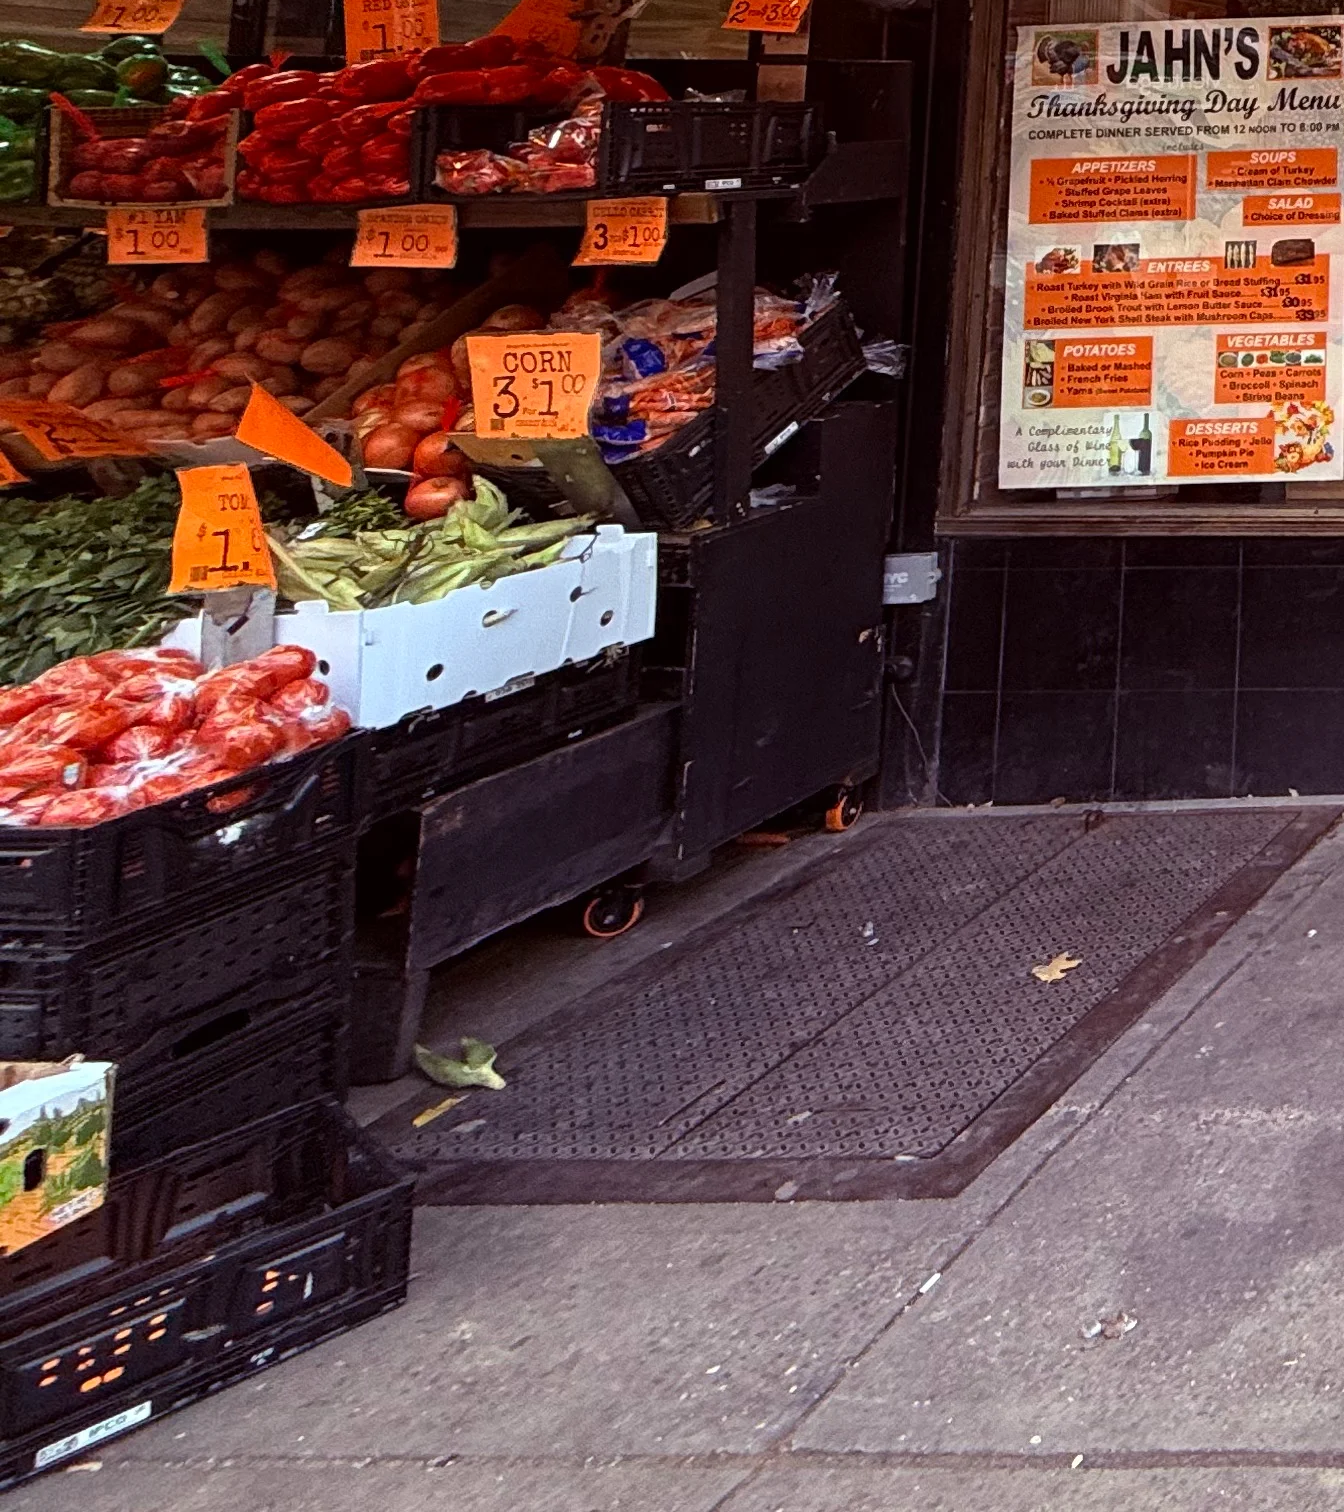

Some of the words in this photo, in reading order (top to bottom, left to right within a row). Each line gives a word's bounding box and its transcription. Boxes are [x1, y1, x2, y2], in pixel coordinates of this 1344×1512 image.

[729, 1, 749, 23] 2
[1107, 27, 1260, 84] JAHN'S
[1027, 94, 1196, 124] Thanksgiving
[1205, 89, 1259, 119] Day
[1267, 87, 1342, 113] Menu
[1028, 129, 1092, 140] COMPLETE
[1096, 127, 1141, 138] DINNER
[1145, 126, 1193, 137] SERVED
[1197, 125, 1230, 135] FROM
[1234, 124, 1246, 134] 12
[1249, 125, 1276, 134] NOON
[1280, 123, 1296, 133] TO
[1326, 124, 1341, 132] PM
[1249, 151, 1297, 164] SOUPS
[1071, 160, 1157, 174] APPETIZERS
[1237, 167, 1268, 176] Cream
[1283, 166, 1315, 176] Turkey
[1057, 176, 1106, 189] Grapefruit
[1114, 175, 1149, 184] Pickled
[1152, 174, 1188, 185] Herring
[1215, 179, 1265, 188] Manhattan
[1294, 177, 1337, 186] Chowder
[1099, 198, 1138, 207] Cocktail
[1268, 197, 1314, 210] SALAD
[1049, 210, 1079, 219] Baked
[1082, 209, 1117, 218] Stuffed
[1119, 208, 1149, 217] Clams
[1251, 212, 1283, 221] Choice
[1286, 211, 1296, 220] of
[1298, 211, 1340, 221] Dressing
[593, 223, 608, 250] 3
[1147, 259, 1211, 273] ENTREES
[1037, 283, 1065, 292] Roast
[1067, 282, 1099, 292] Turkey
[1101, 281, 1122, 289] with
[1148, 280, 1174, 289] Grain
[1071, 293, 1099, 301] Roast
[1101, 293, 1138, 302] Virginia
[1165, 291, 1185, 299] with
[1187, 290, 1210, 299] Fruit
[1212, 289, 1241, 298] Sauce
[1048, 305, 1082, 314] Broiled
[1117, 304, 1142, 312] Trout
[1145, 303, 1165, 311] with
[1235, 300, 1262, 308] Sauce
[1034, 317, 1068, 326] Broiled
[1071, 316, 1091, 325] New
[1145, 314, 1171, 322] Steak
[1249, 311, 1274, 321] Caps
[1227, 334, 1315, 348] VEGETABLES
[1063, 343, 1136, 357] POTATOES
[503, 350, 572, 373] CORN
[1068, 363, 1098, 372] Baked
[1114, 362, 1151, 371] Mashed
[1067, 375, 1101, 383] French
[1104, 374, 1128, 382] Fries
[1220, 370, 1244, 379] Corn
[1253, 369, 1277, 378] Peas
[1286, 368, 1322, 377] Carrots
[1067, 387, 1093, 395] Yams
[1230, 381, 1270, 390] Broccoli
[1279, 380, 1319, 390] Spinach
[492, 375, 520, 419] 3
[1242, 392, 1272, 402] String
[1275, 392, 1305, 400] Beans
[1029, 425, 1113, 438] Complimentary
[1185, 422, 1258, 436] DESSERTS
[1028, 441, 1060, 452] Glass
[1066, 441, 1079, 453] of
[1178, 439, 1199, 447] Rice
[1202, 438, 1241, 448] Pudding
[1250, 437, 1272, 446] Jello
[1196, 450, 1237, 460] Pumpkin
[1240, 449, 1254, 458] Pie
[1007, 459, 1034, 468] with
[1218, 460, 1248, 469] Cream
